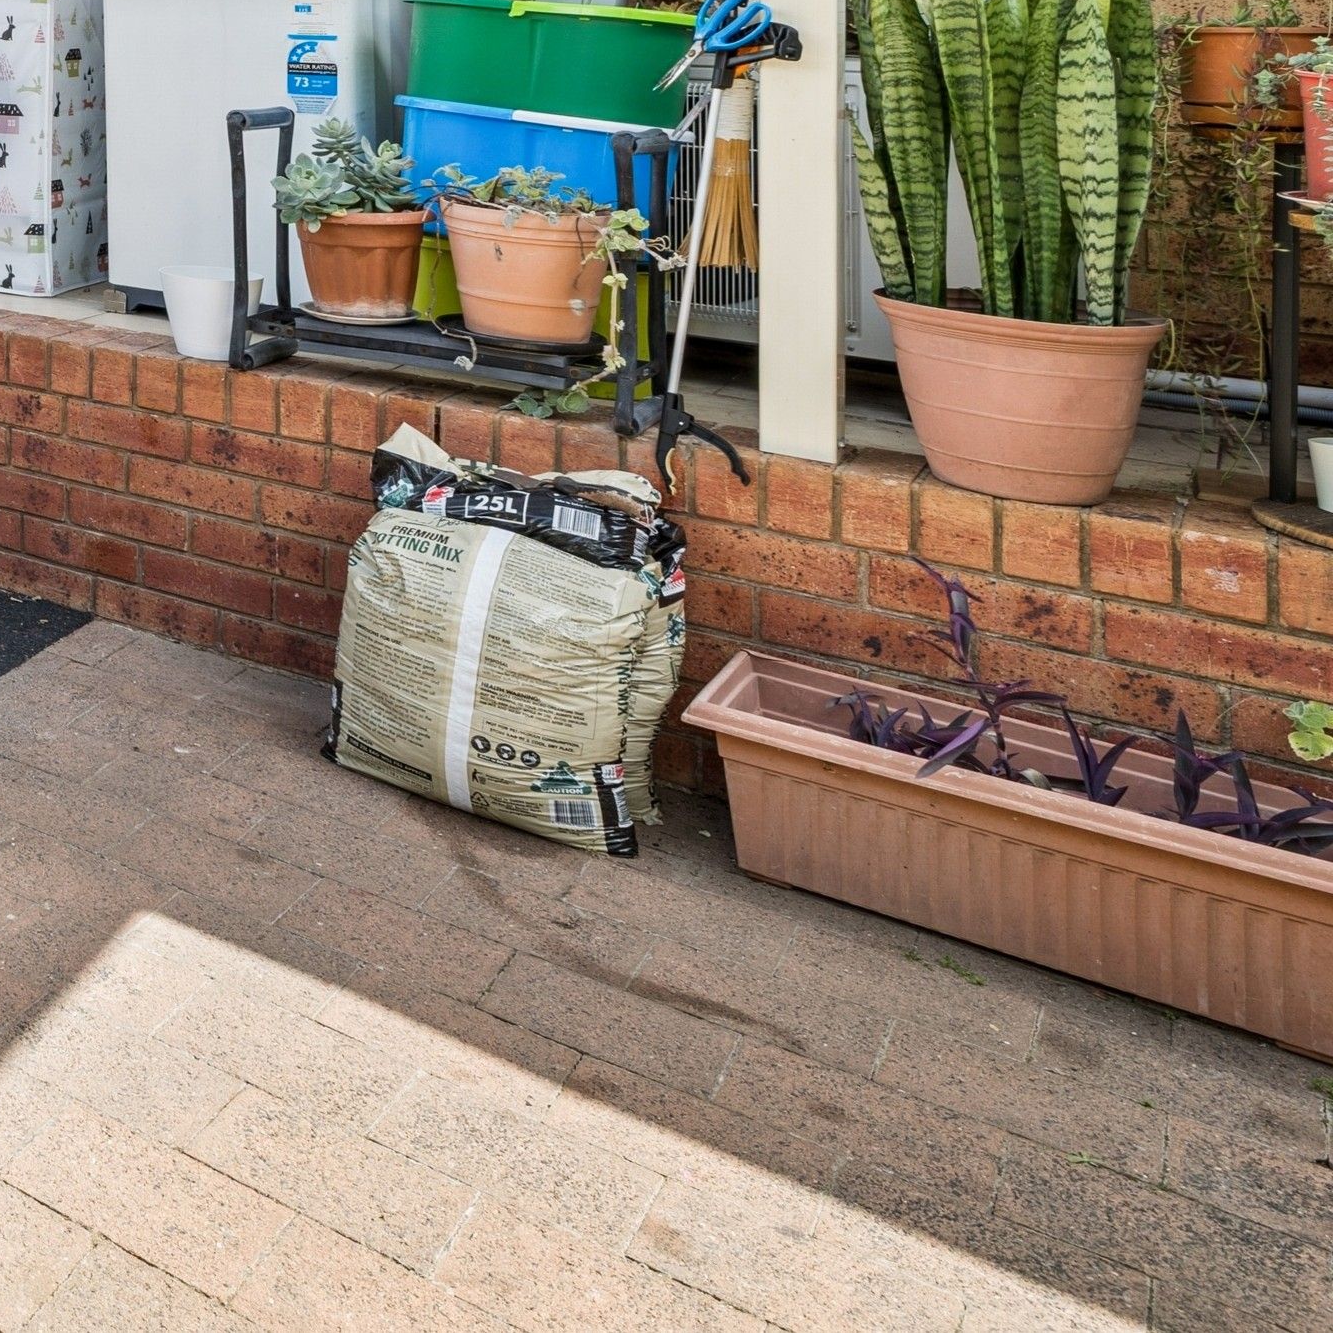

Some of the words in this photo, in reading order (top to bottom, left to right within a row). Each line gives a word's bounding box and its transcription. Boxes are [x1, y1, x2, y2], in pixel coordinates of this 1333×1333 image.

[294, 76, 309, 88] 73
[474, 495, 518, 514] 25L
[391, 525, 450, 545] PREMIUM
[433, 544, 464, 563] MIX
